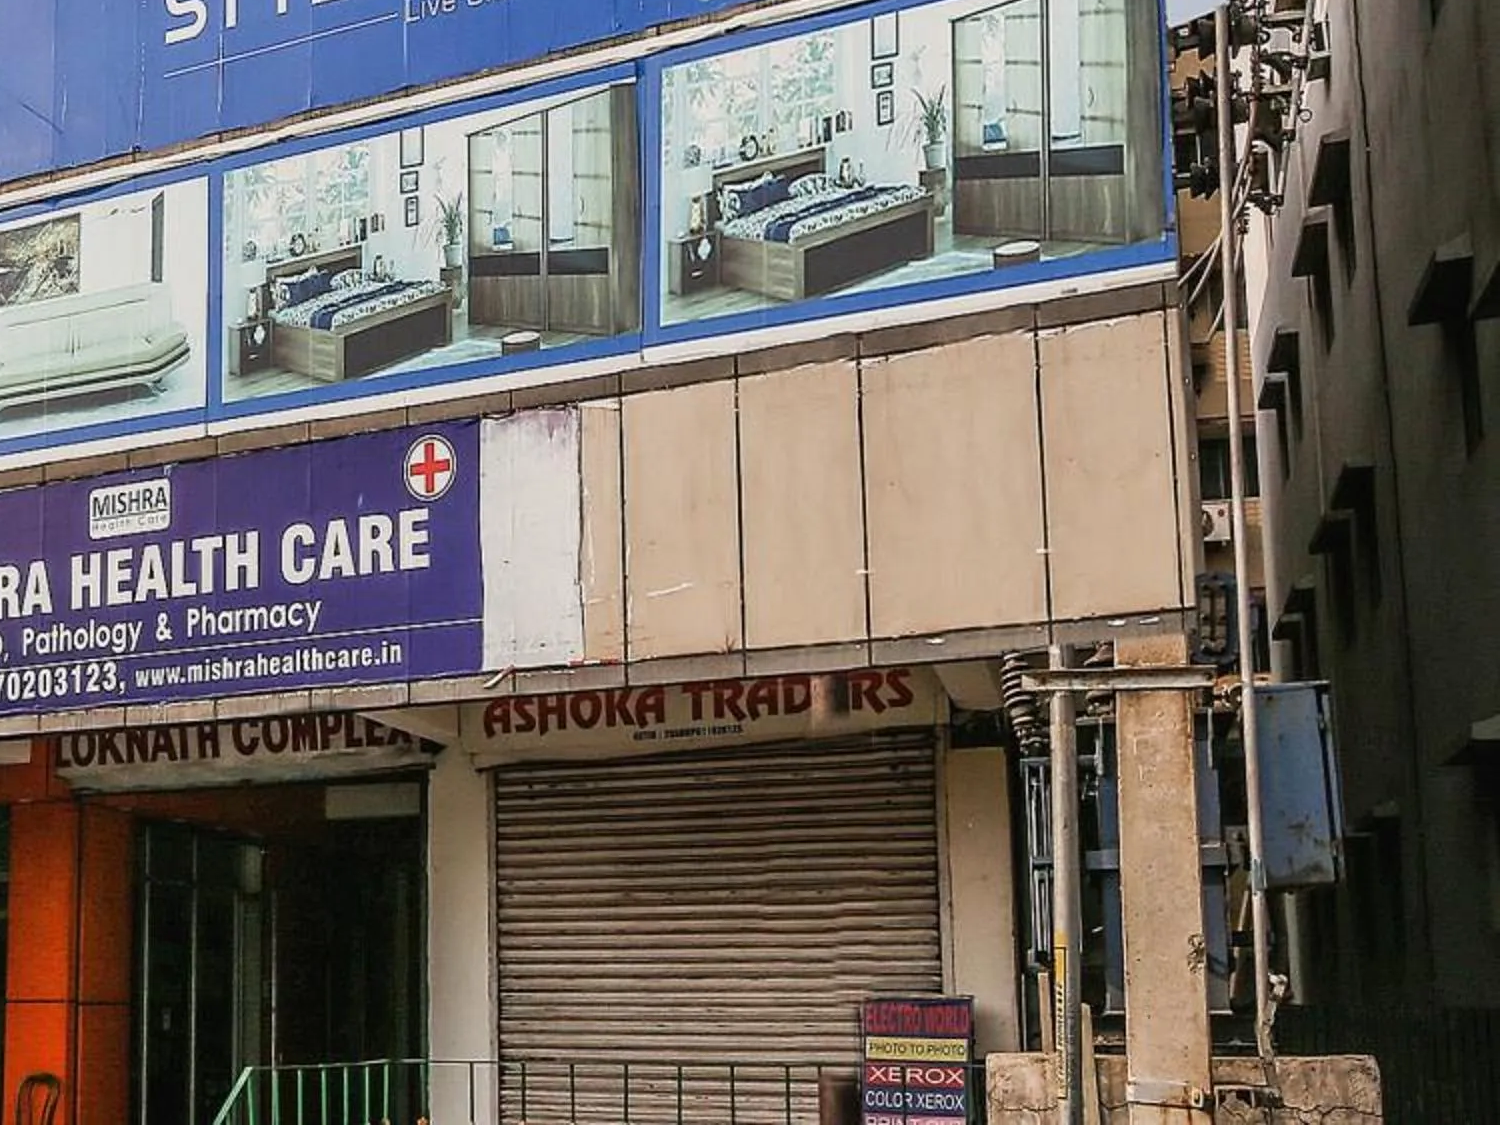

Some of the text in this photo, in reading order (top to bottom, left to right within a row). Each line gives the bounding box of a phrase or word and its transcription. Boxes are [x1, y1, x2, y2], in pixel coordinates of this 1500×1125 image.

[92, 487, 168, 517] MISHRA
[70, 530, 260, 610] HEALTH
[280, 508, 431, 584] CARE
[22, 618, 142, 655] Pathology
[155, 613, 173, 641] &
[186, 597, 322, 638] Pharmacy
[135, 641, 402, 689] www.mishrahealthcare.in
[483, 669, 914, 738] ASHOKA TRADRS
[56, 721, 220, 769] LOKNATH
[869, 1041, 966, 1057] PHOTO TO PHOTO
[869, 1066, 965, 1085] XEROX
[865, 1090, 965, 1111] COLOR XEROX
